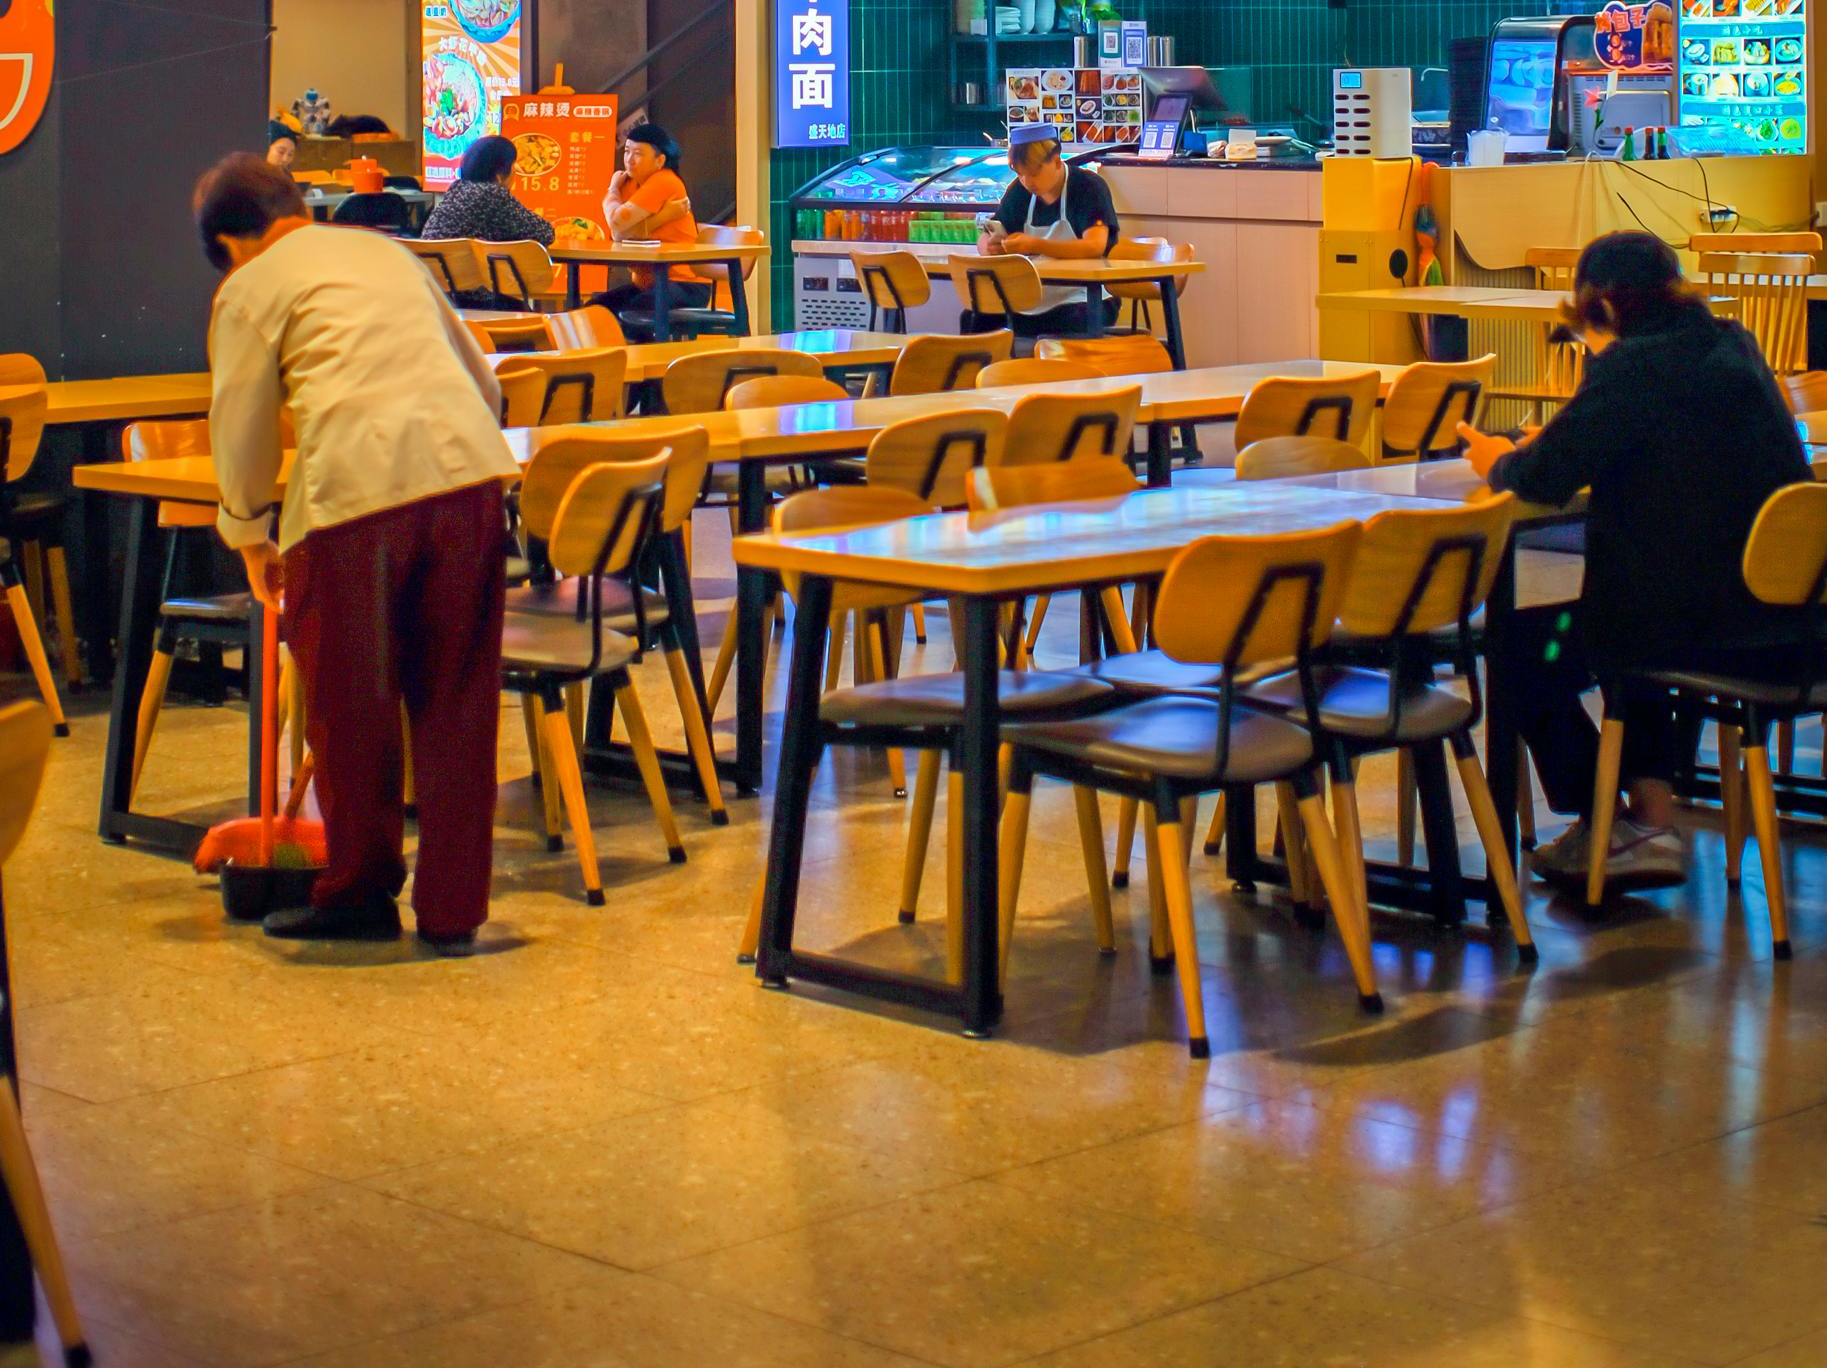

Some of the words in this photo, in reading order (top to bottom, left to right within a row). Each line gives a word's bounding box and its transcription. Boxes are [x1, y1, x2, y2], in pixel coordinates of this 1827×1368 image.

[523, 102, 570, 119] 麻辣烫
[808, 123, 845, 140] 盛天地店
[511, 176, 560, 191] 15.8
